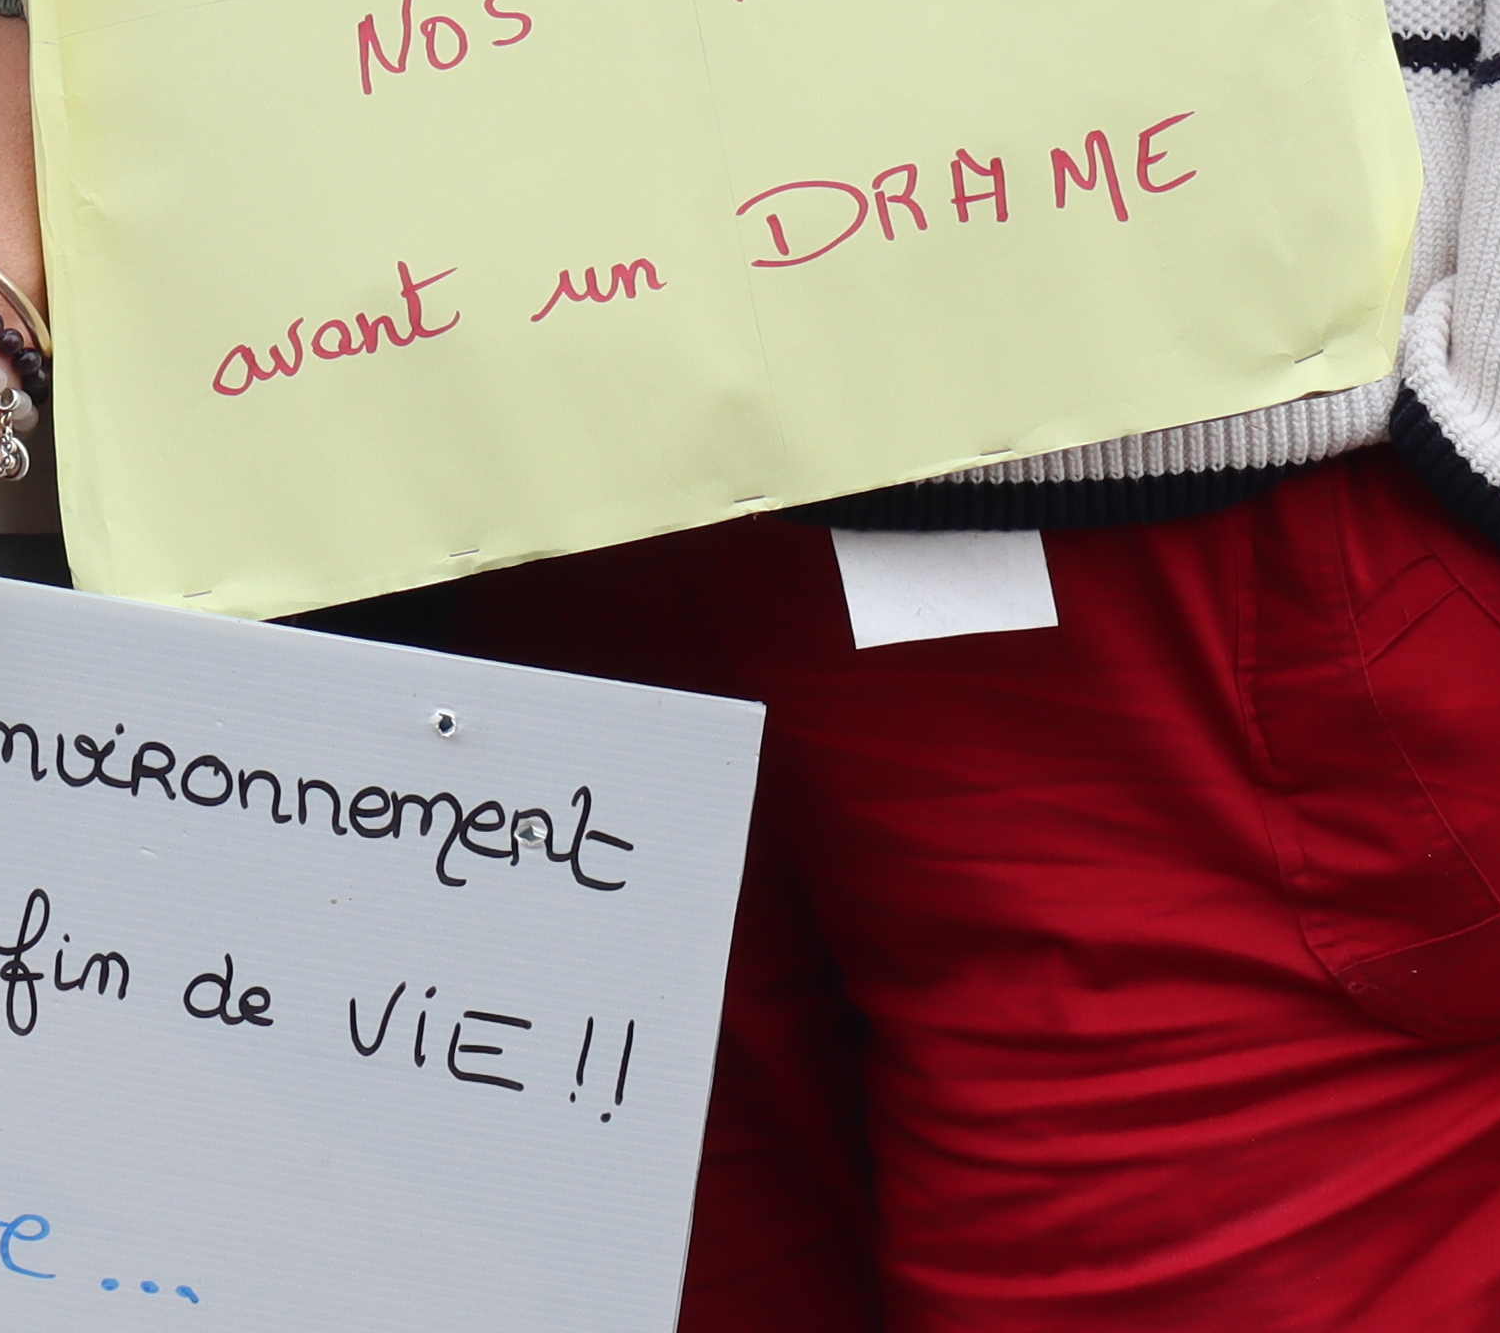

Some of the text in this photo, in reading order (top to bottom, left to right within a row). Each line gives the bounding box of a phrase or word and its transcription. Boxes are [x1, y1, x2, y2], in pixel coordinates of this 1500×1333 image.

[213, 112, 1196, 396] avant un DRAME
[183, 953, 274, 1027] de
